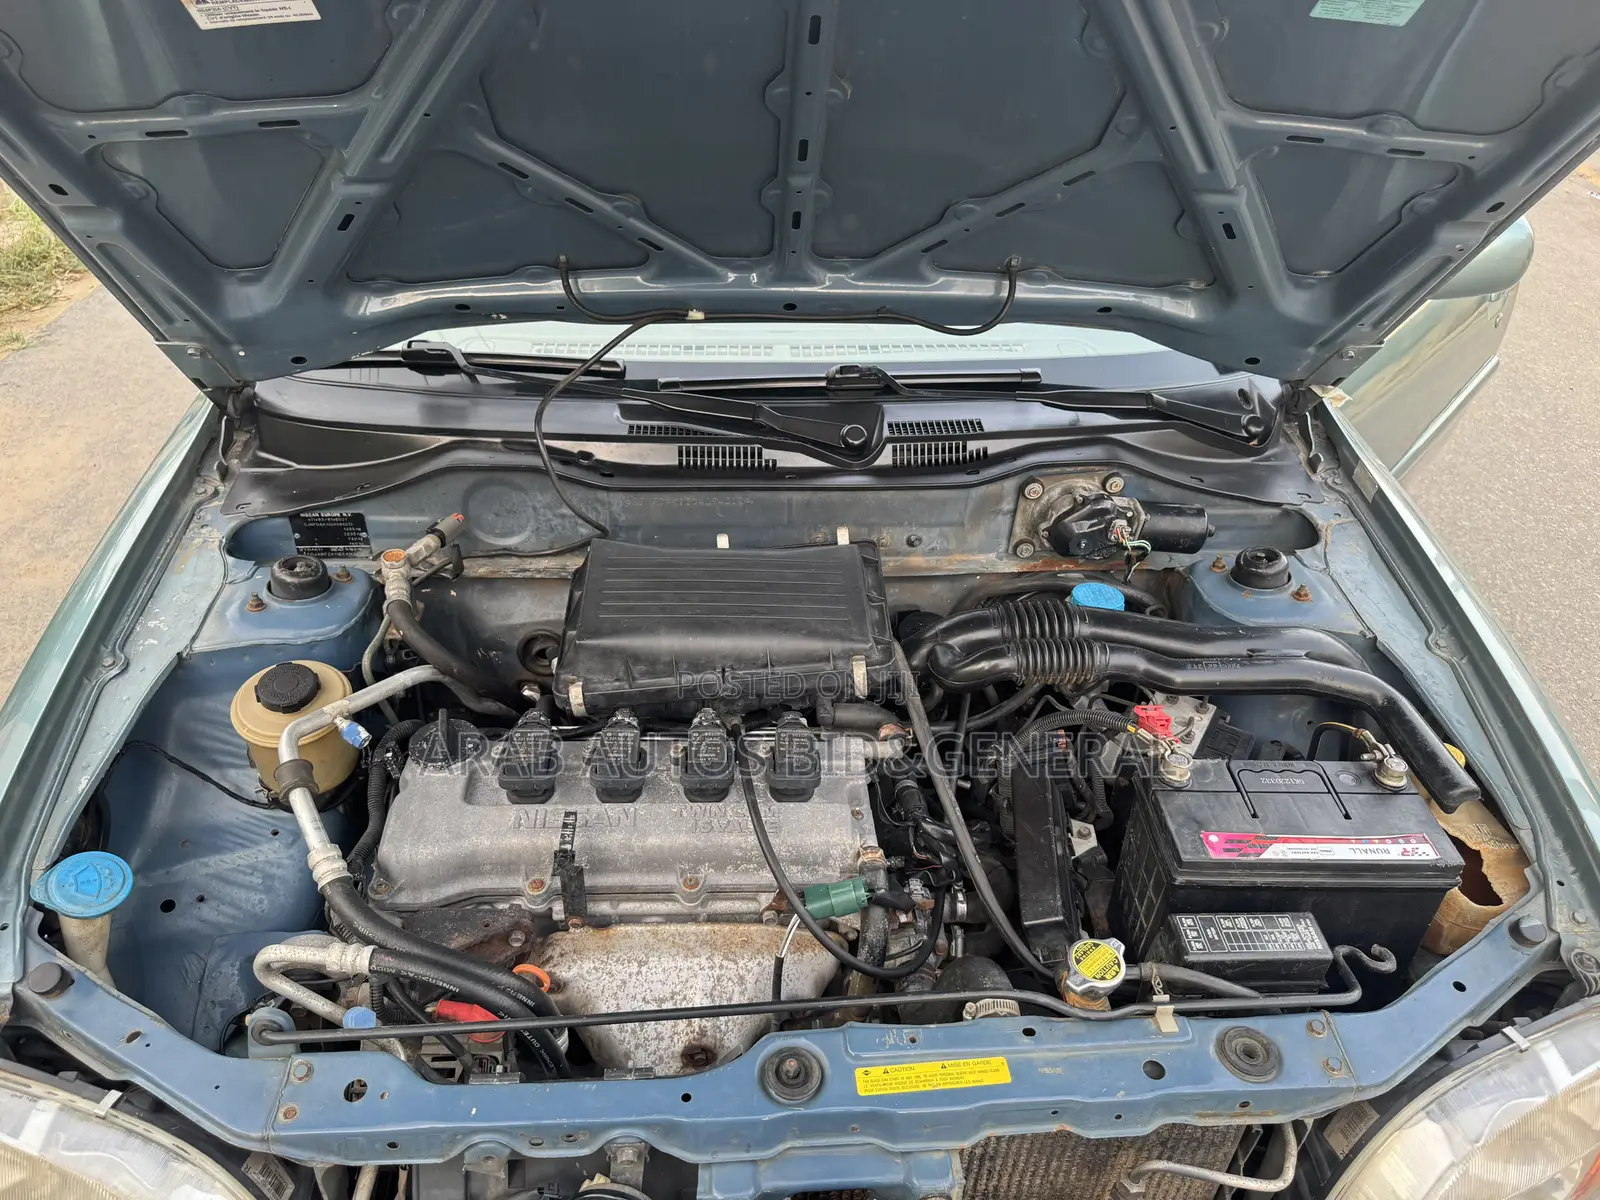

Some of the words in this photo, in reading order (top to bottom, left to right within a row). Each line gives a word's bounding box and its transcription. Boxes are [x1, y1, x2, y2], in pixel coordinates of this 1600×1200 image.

[1348, 847, 1391, 855] RUNALL
[1095, 958, 1119, 979] CAUTION
[889, 1066, 915, 1074] CAUTION
